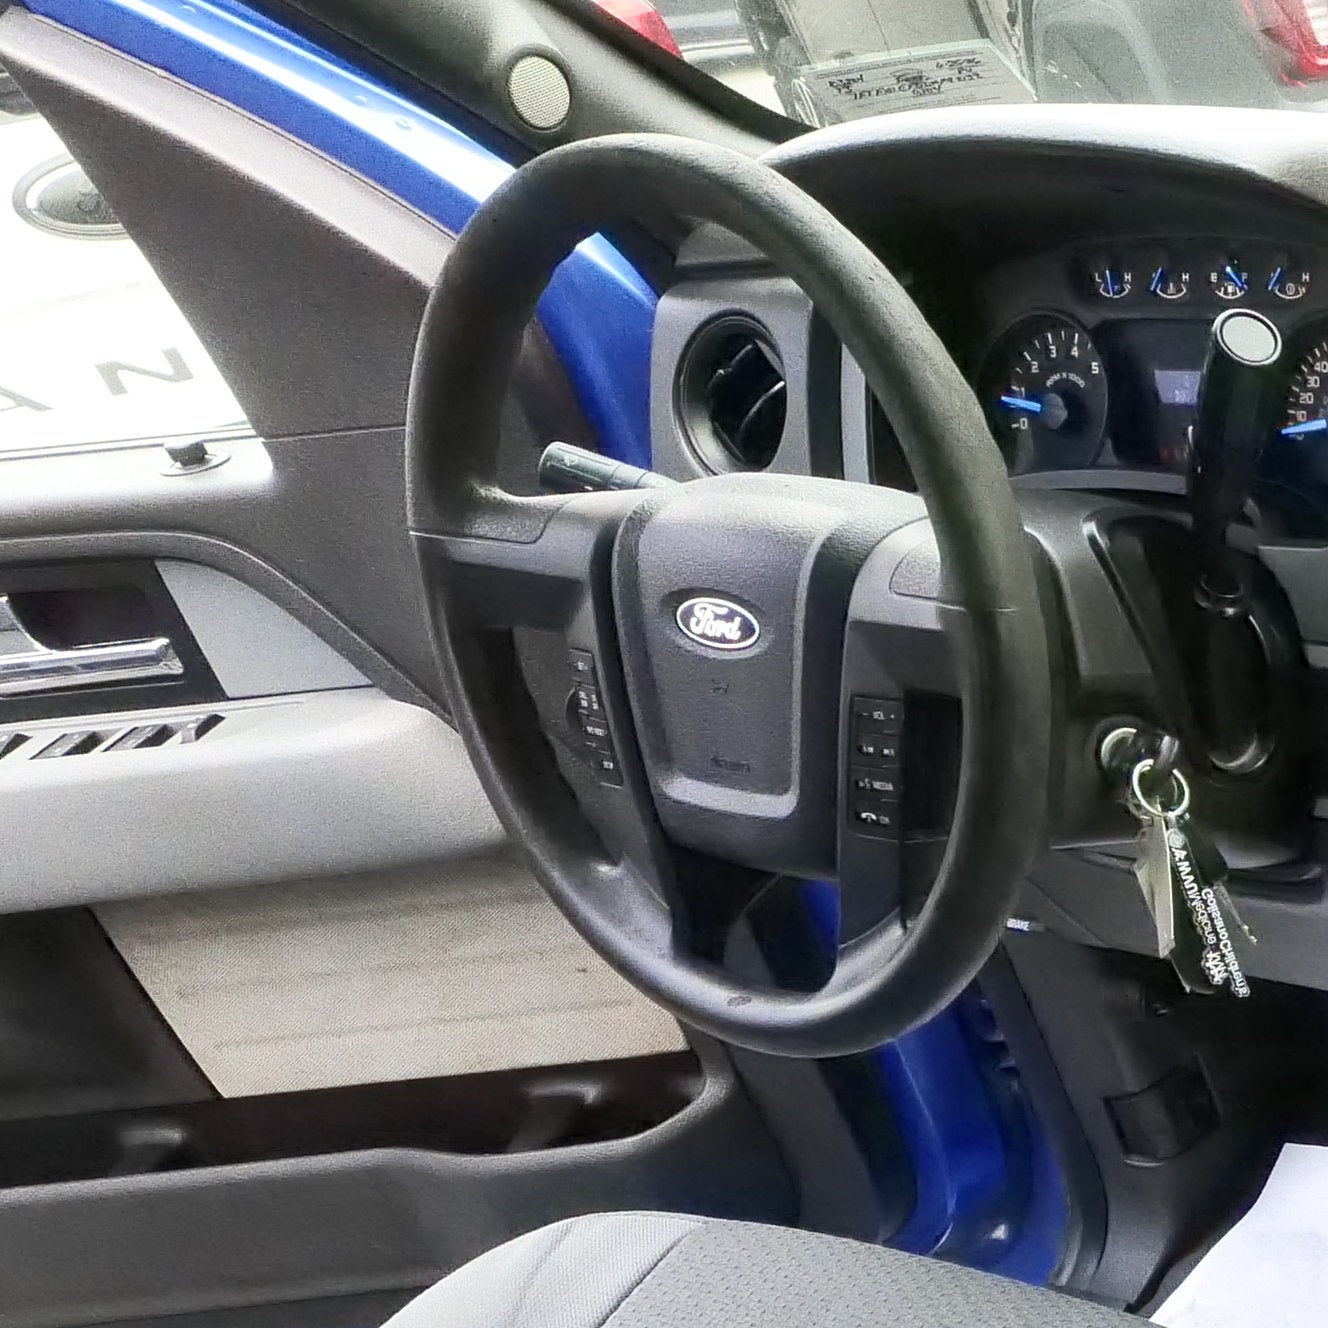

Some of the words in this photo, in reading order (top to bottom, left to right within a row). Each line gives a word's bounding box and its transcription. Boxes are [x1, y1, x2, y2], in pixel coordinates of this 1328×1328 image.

[1124, 273, 1131, 282] H
[1182, 273, 1189, 282] H
[1302, 273, 1309, 282] H
[1050, 346, 1057, 358] 3
[1071, 346, 1079, 358] 4
[1031, 361, 1039, 373] 2
[1091, 362, 1099, 374] 5
[1314, 361, 1328, 373] 40
[1306, 376, 1320, 388] 30
[1299, 393, 1314, 404] 20
[689, 602, 742, 640] Ford
